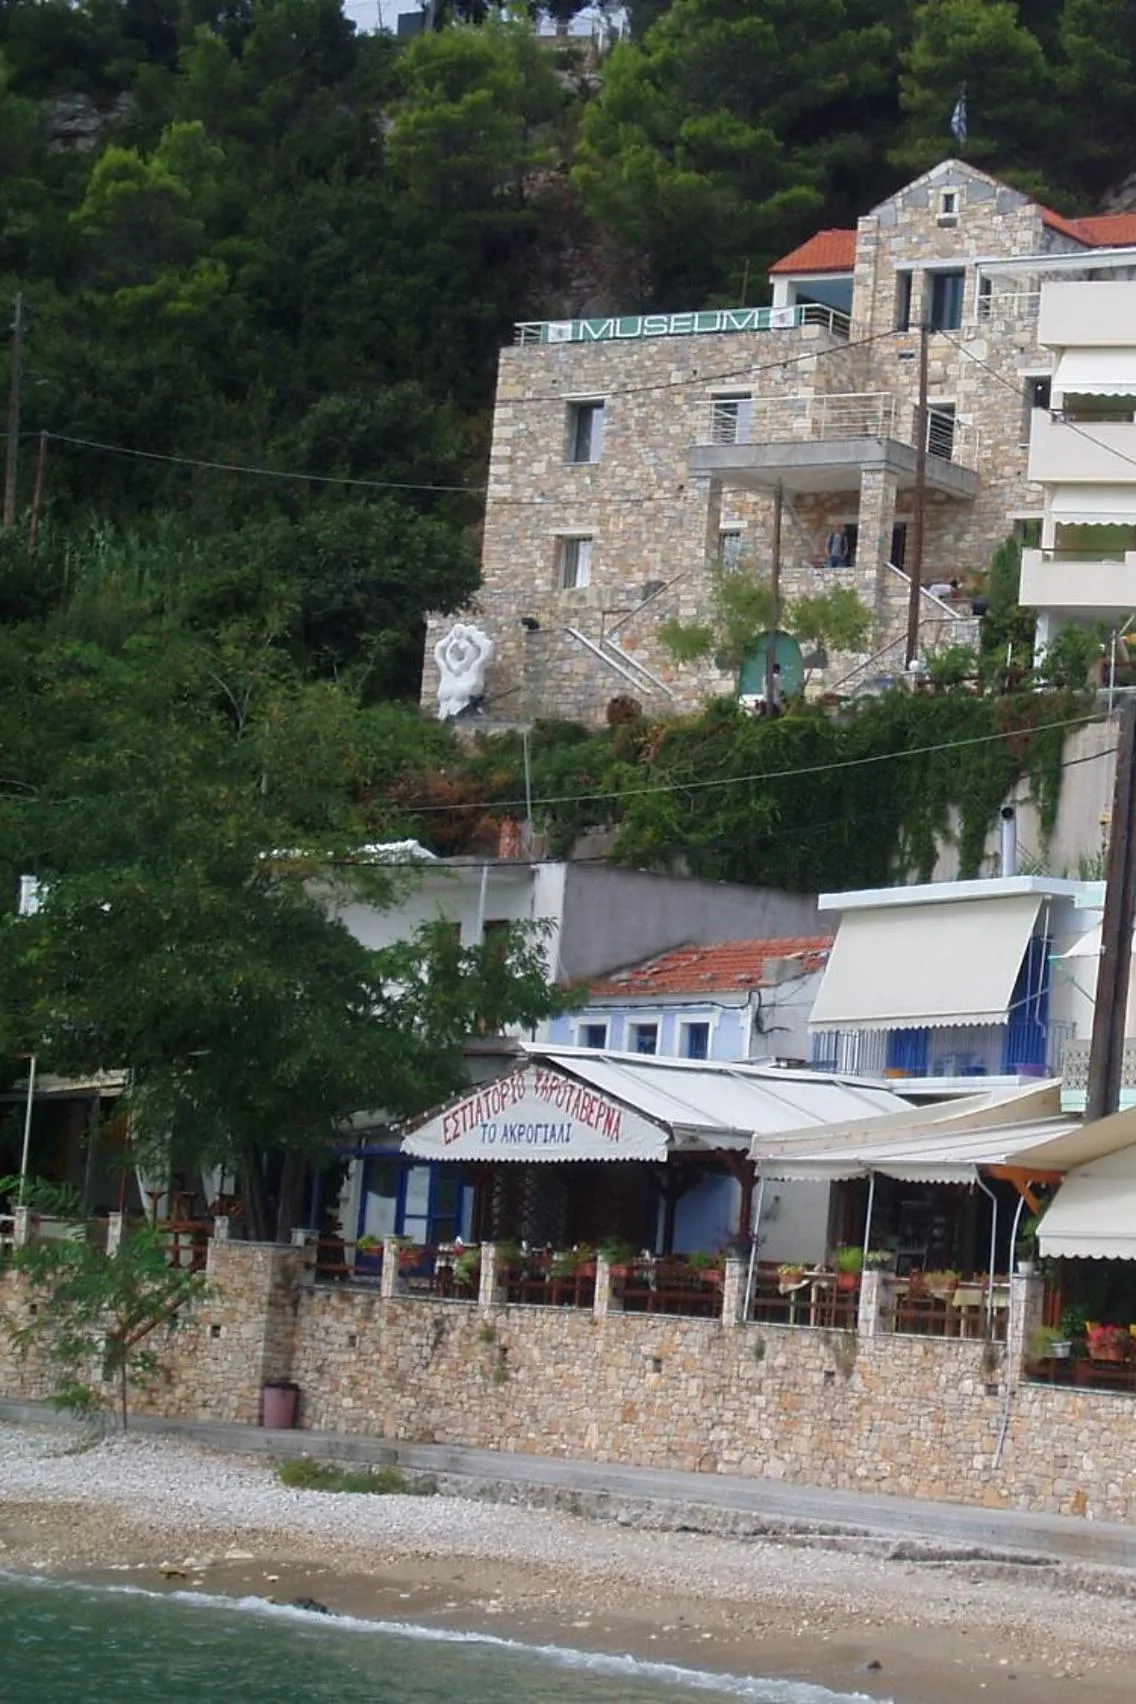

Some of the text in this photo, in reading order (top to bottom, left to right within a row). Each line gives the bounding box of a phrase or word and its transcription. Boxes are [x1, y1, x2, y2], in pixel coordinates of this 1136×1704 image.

[578, 308, 760, 341] MUSEUM
[442, 1073, 526, 1145] ΕΣΤΙΑΤΟΡΙΟ
[480, 1123, 573, 1144] ΤΟ ΑΚΡΟΓΙΑΛΙ
